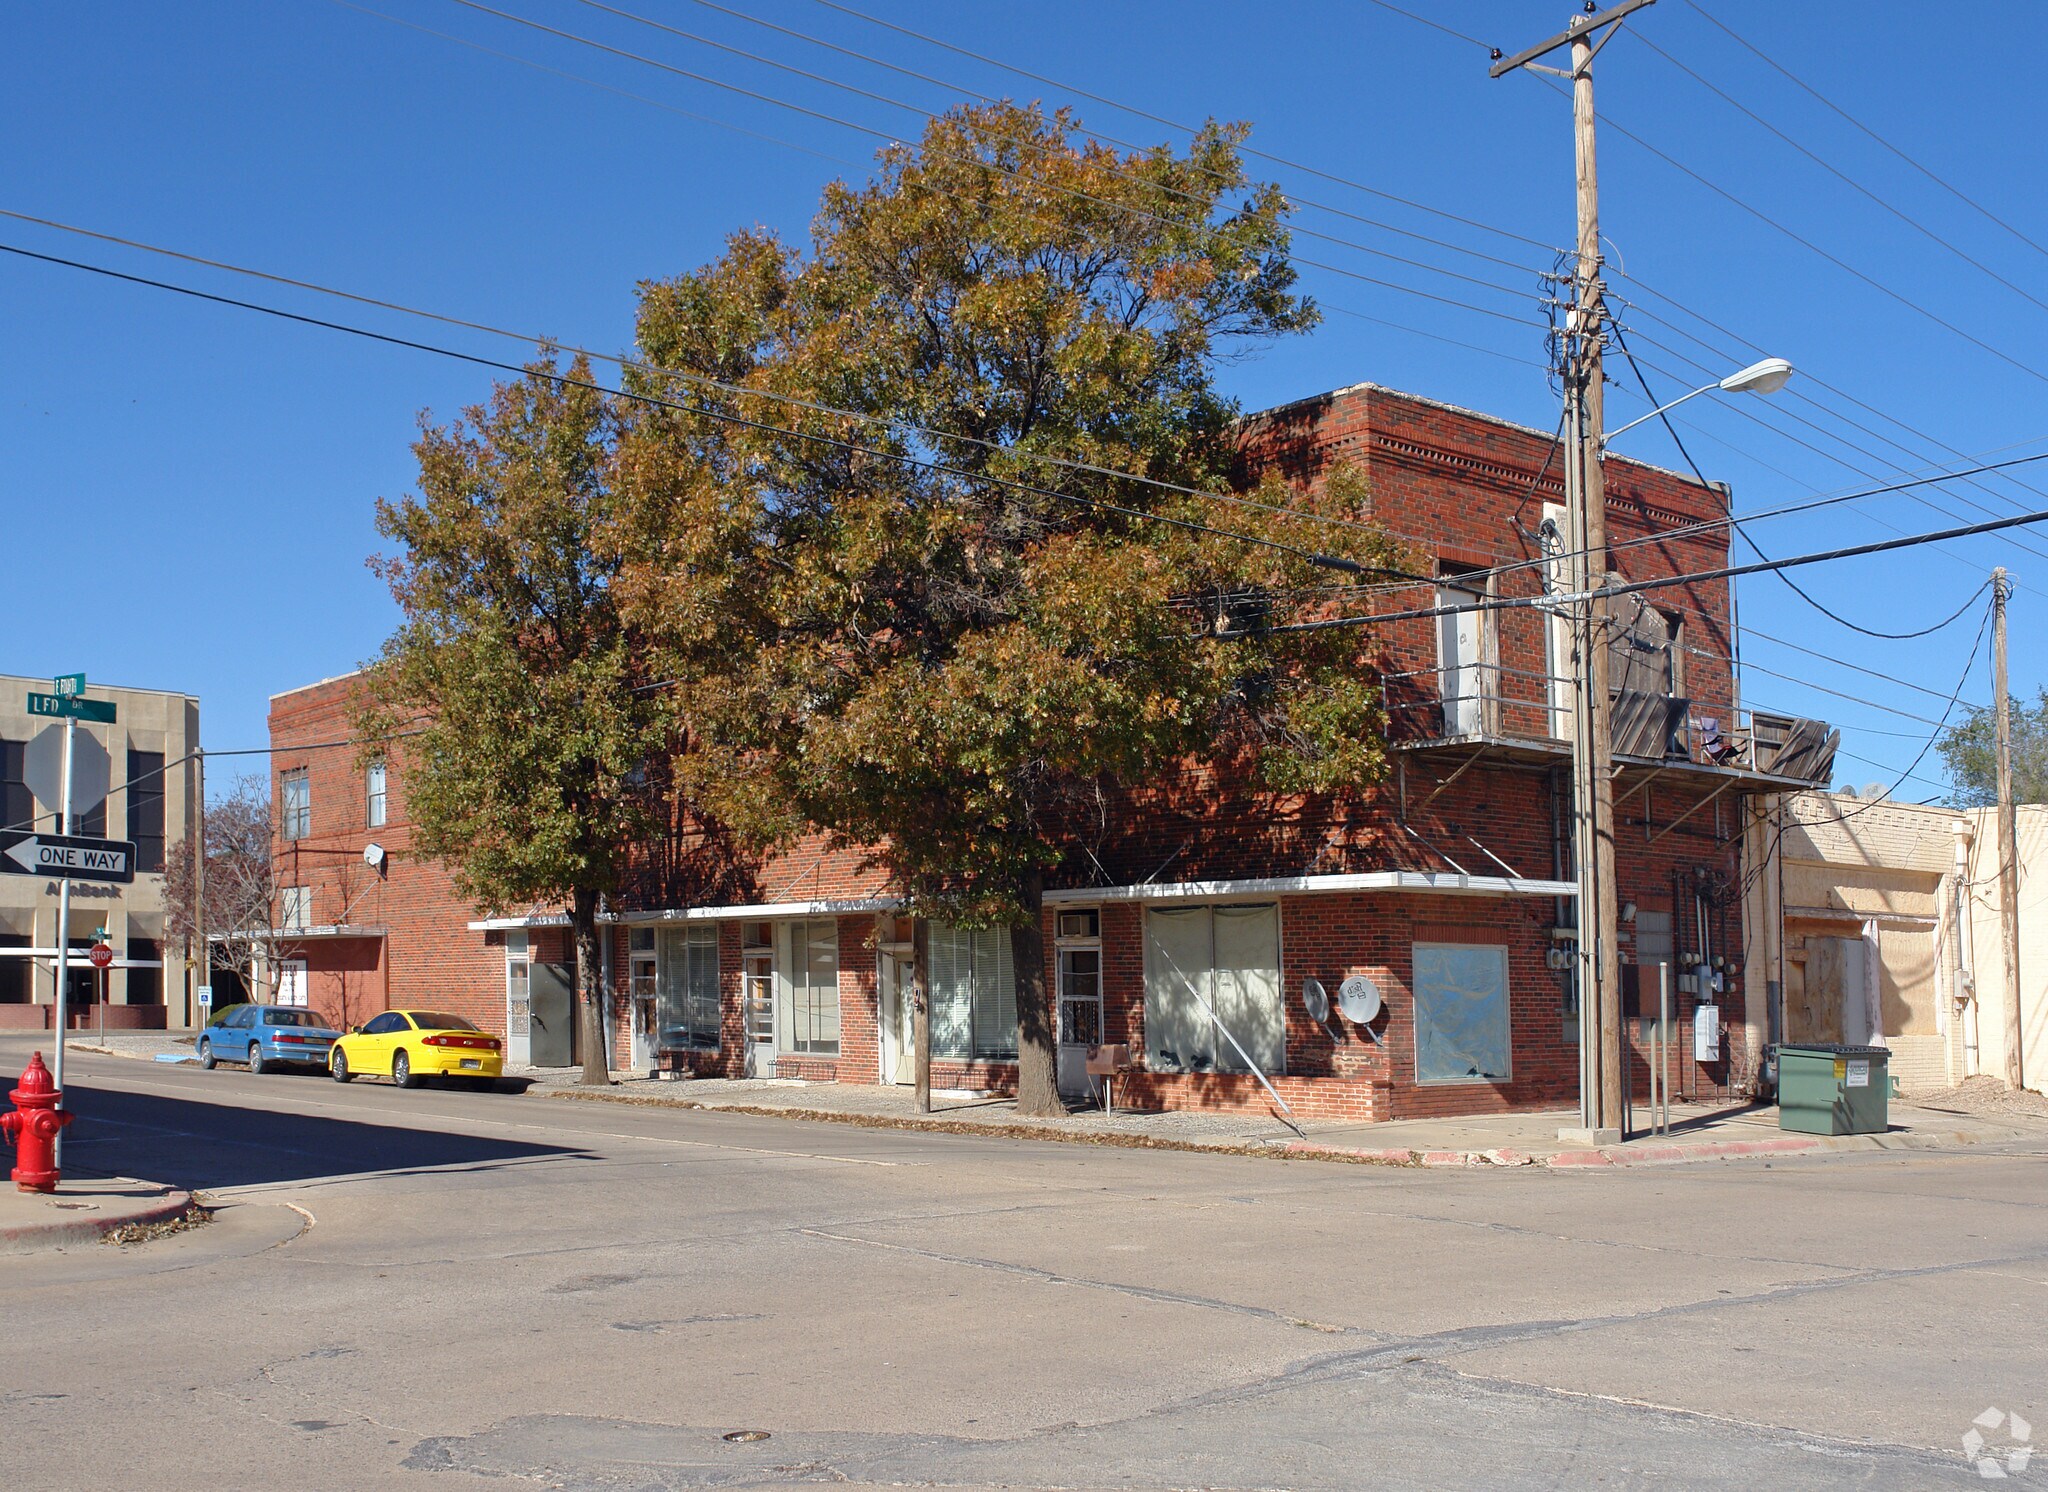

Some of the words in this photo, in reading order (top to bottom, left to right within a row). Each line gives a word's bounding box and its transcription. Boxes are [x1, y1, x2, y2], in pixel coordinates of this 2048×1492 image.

[72, 701, 83, 710] DR
[40, 847, 76, 866] ONE
[84, 852, 120, 868] WAY
[91, 950, 112, 961] STOP
